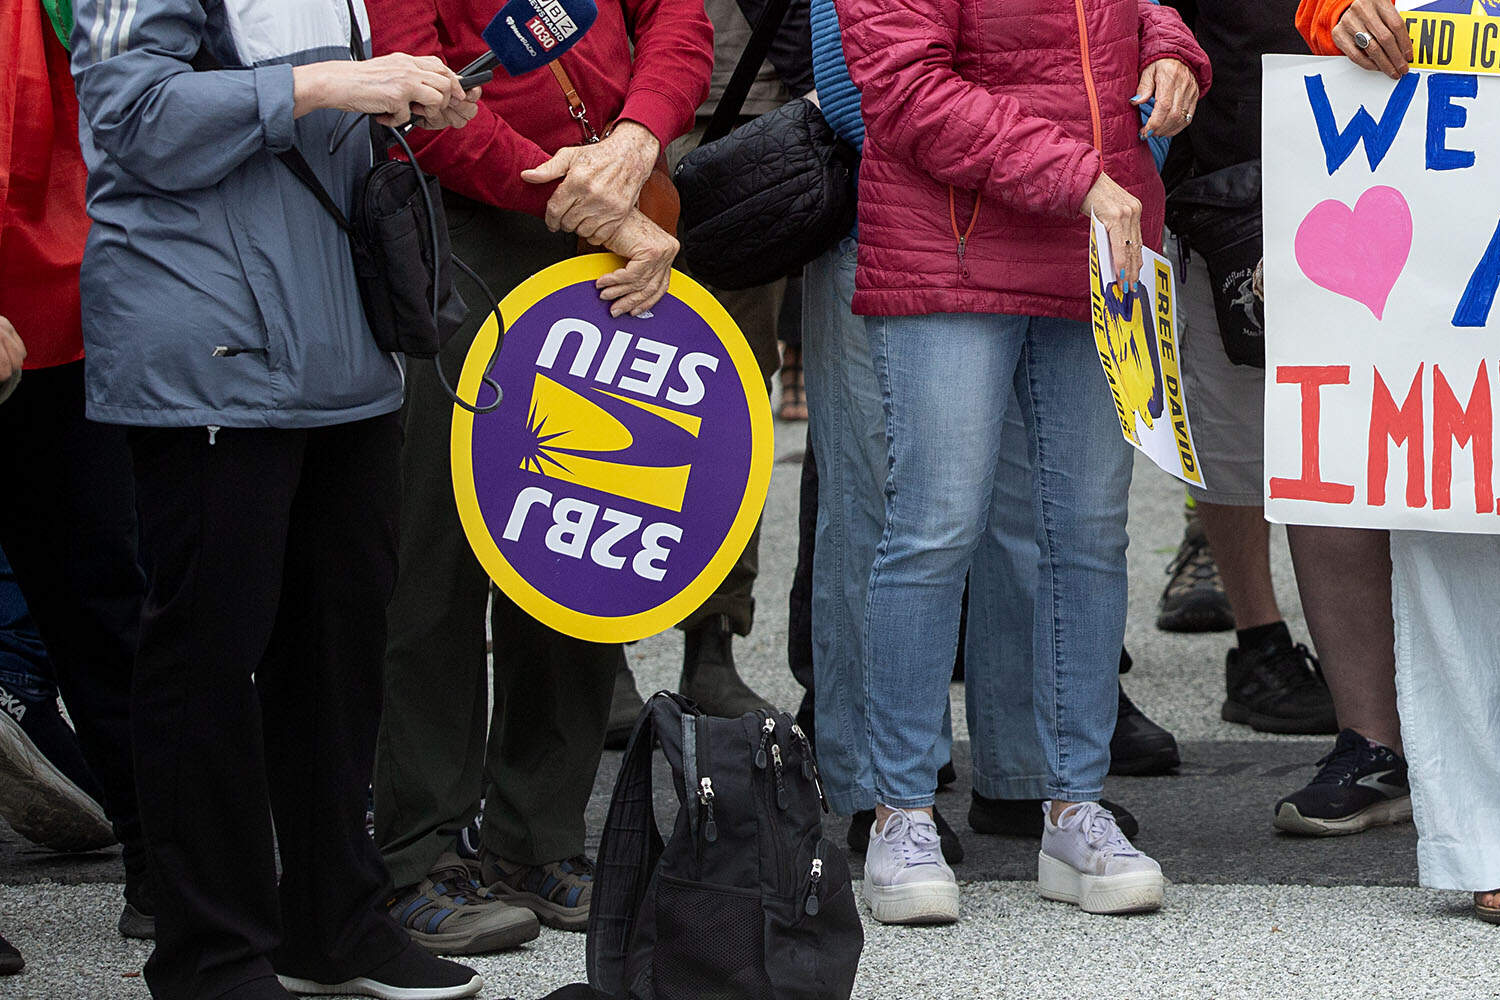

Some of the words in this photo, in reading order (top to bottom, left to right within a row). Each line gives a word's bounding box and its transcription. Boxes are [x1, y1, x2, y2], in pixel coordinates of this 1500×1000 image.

[529, 18, 555, 49] 1030
[1304, 71, 1479, 176] WE
[535, 318, 720, 406] SEIU
[1092, 291, 1105, 336] ICE
[1099, 351, 1132, 434] RAIDS
[1156, 268, 1175, 363] FREE
[1165, 374, 1195, 473] DAVID
[502, 486, 683, 582] 32BJ
